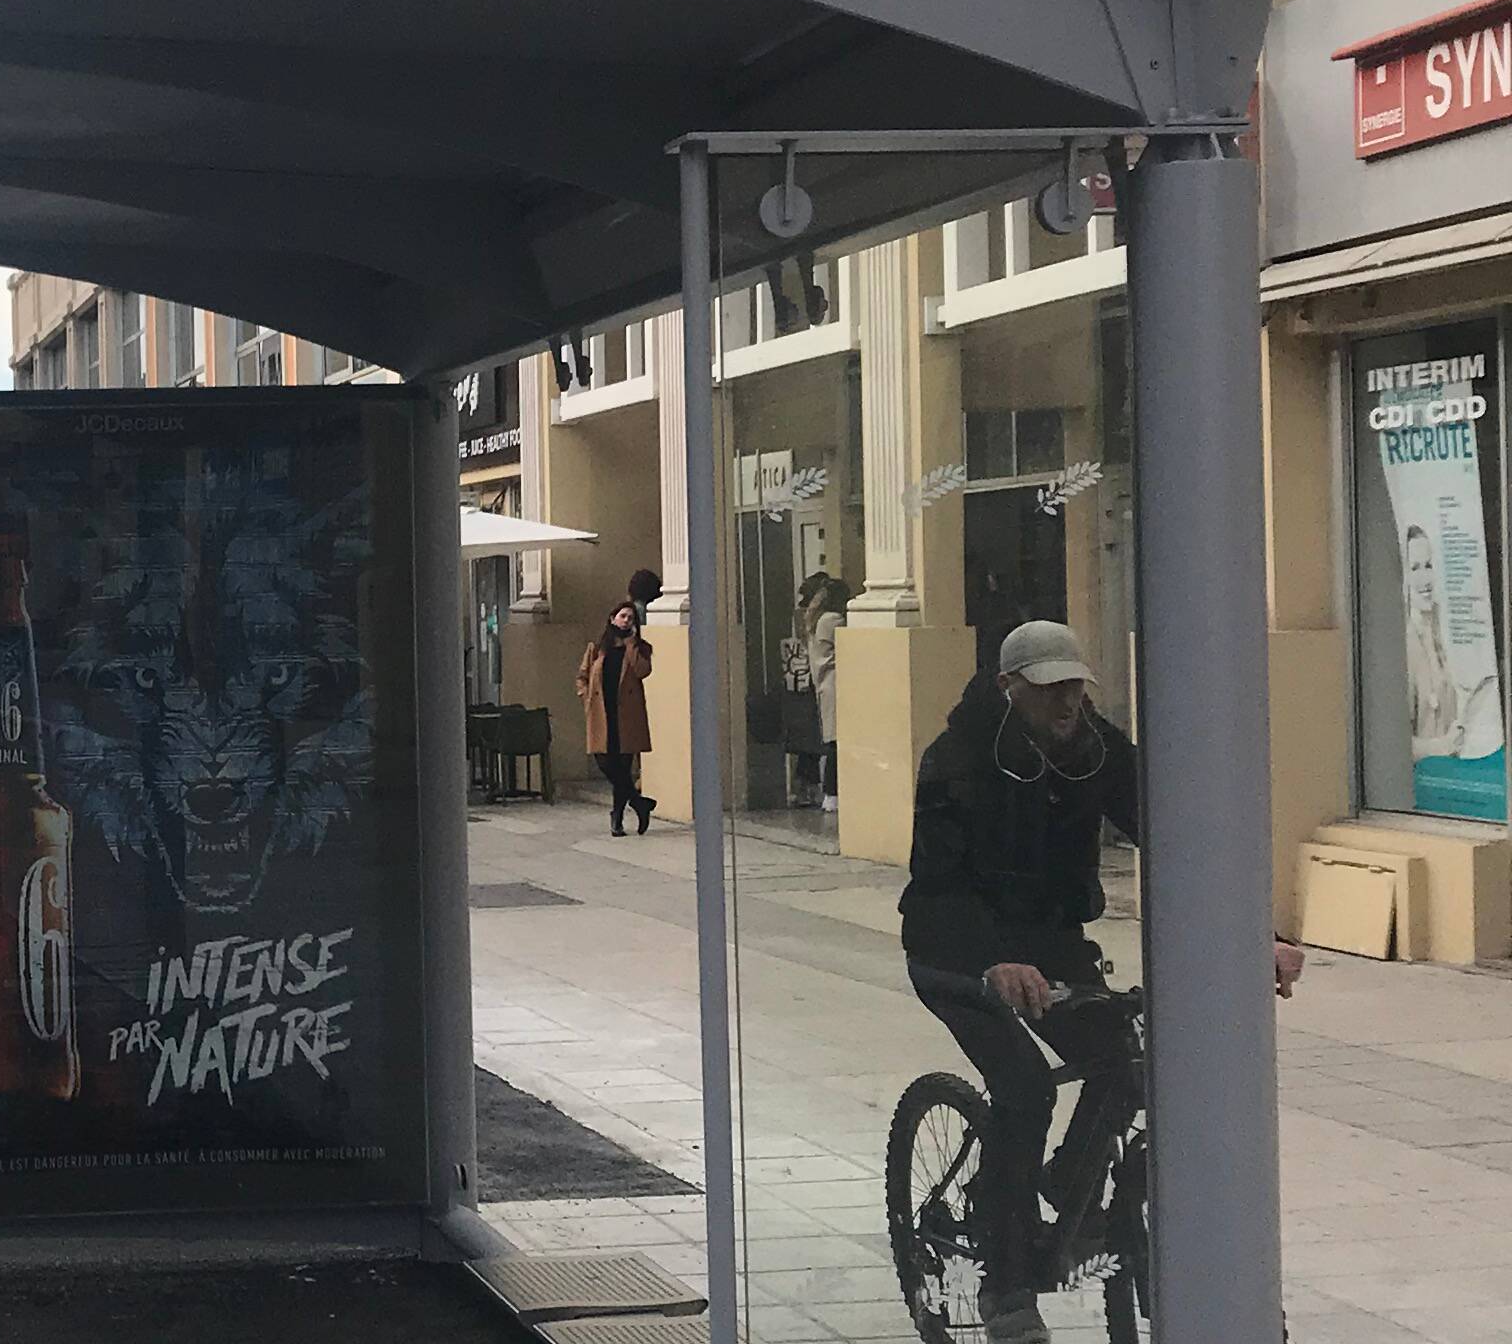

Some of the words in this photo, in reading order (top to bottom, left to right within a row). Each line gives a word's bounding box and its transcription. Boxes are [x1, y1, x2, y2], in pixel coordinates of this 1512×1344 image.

[1425, 22, 1511, 118] SYN
[1367, 354, 1485, 392] INTERIM
[74, 415, 185, 433] JCDecaux
[1369, 404, 1414, 430] CDI
[1426, 395, 1487, 424] CDD
[146, 927, 354, 1016] INTENSE
[108, 1019, 164, 1062] PAR
[146, 1000, 354, 1107] NATURE
[34, 1154, 98, 1170] DANGEREUX
[103, 1153, 132, 1167] POUR
[136, 1152, 151, 1165] LA
[210, 1148, 279, 1163] CONSOMMER
[283, 1147, 311, 1161] AVEC
